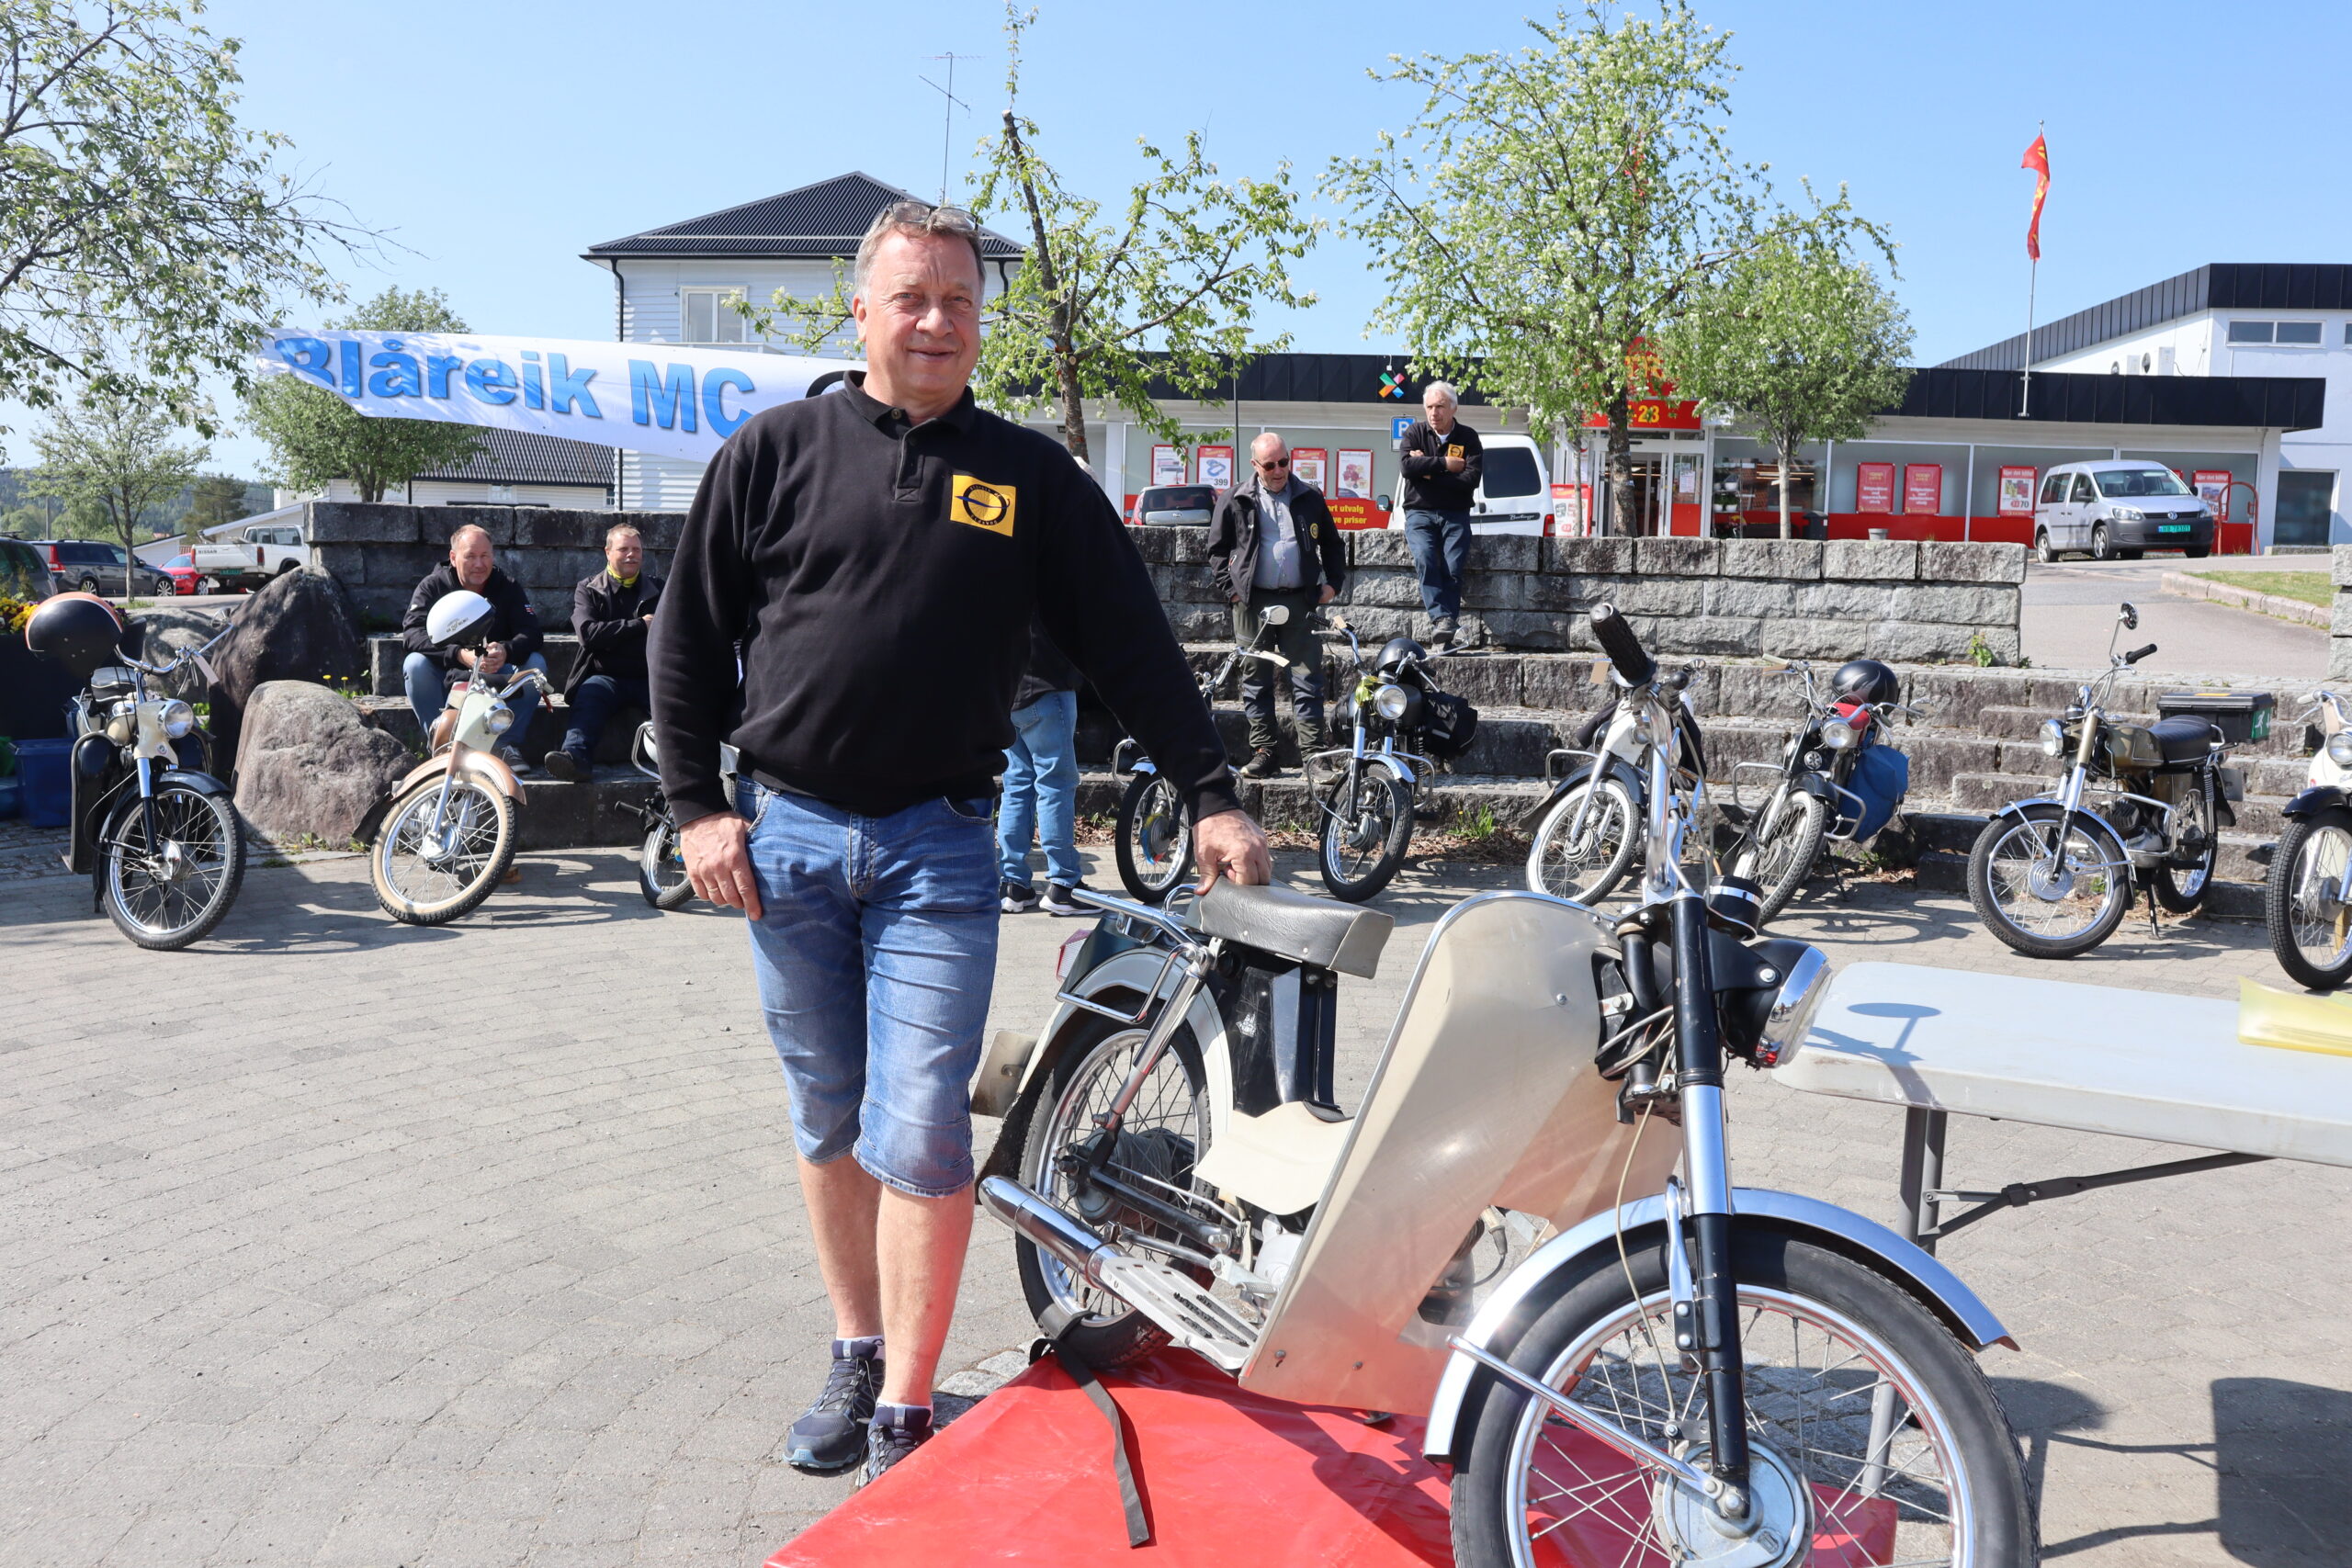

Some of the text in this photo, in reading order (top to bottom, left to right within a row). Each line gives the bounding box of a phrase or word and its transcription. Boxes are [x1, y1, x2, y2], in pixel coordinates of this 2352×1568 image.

[275, 336, 755, 439] Blåreik MC
[1398, 421, 1409, 437] P
[1214, 478, 1228, 486] 399
[1340, 504, 1364, 513] utvalg
[1343, 516, 1367, 525] priser
